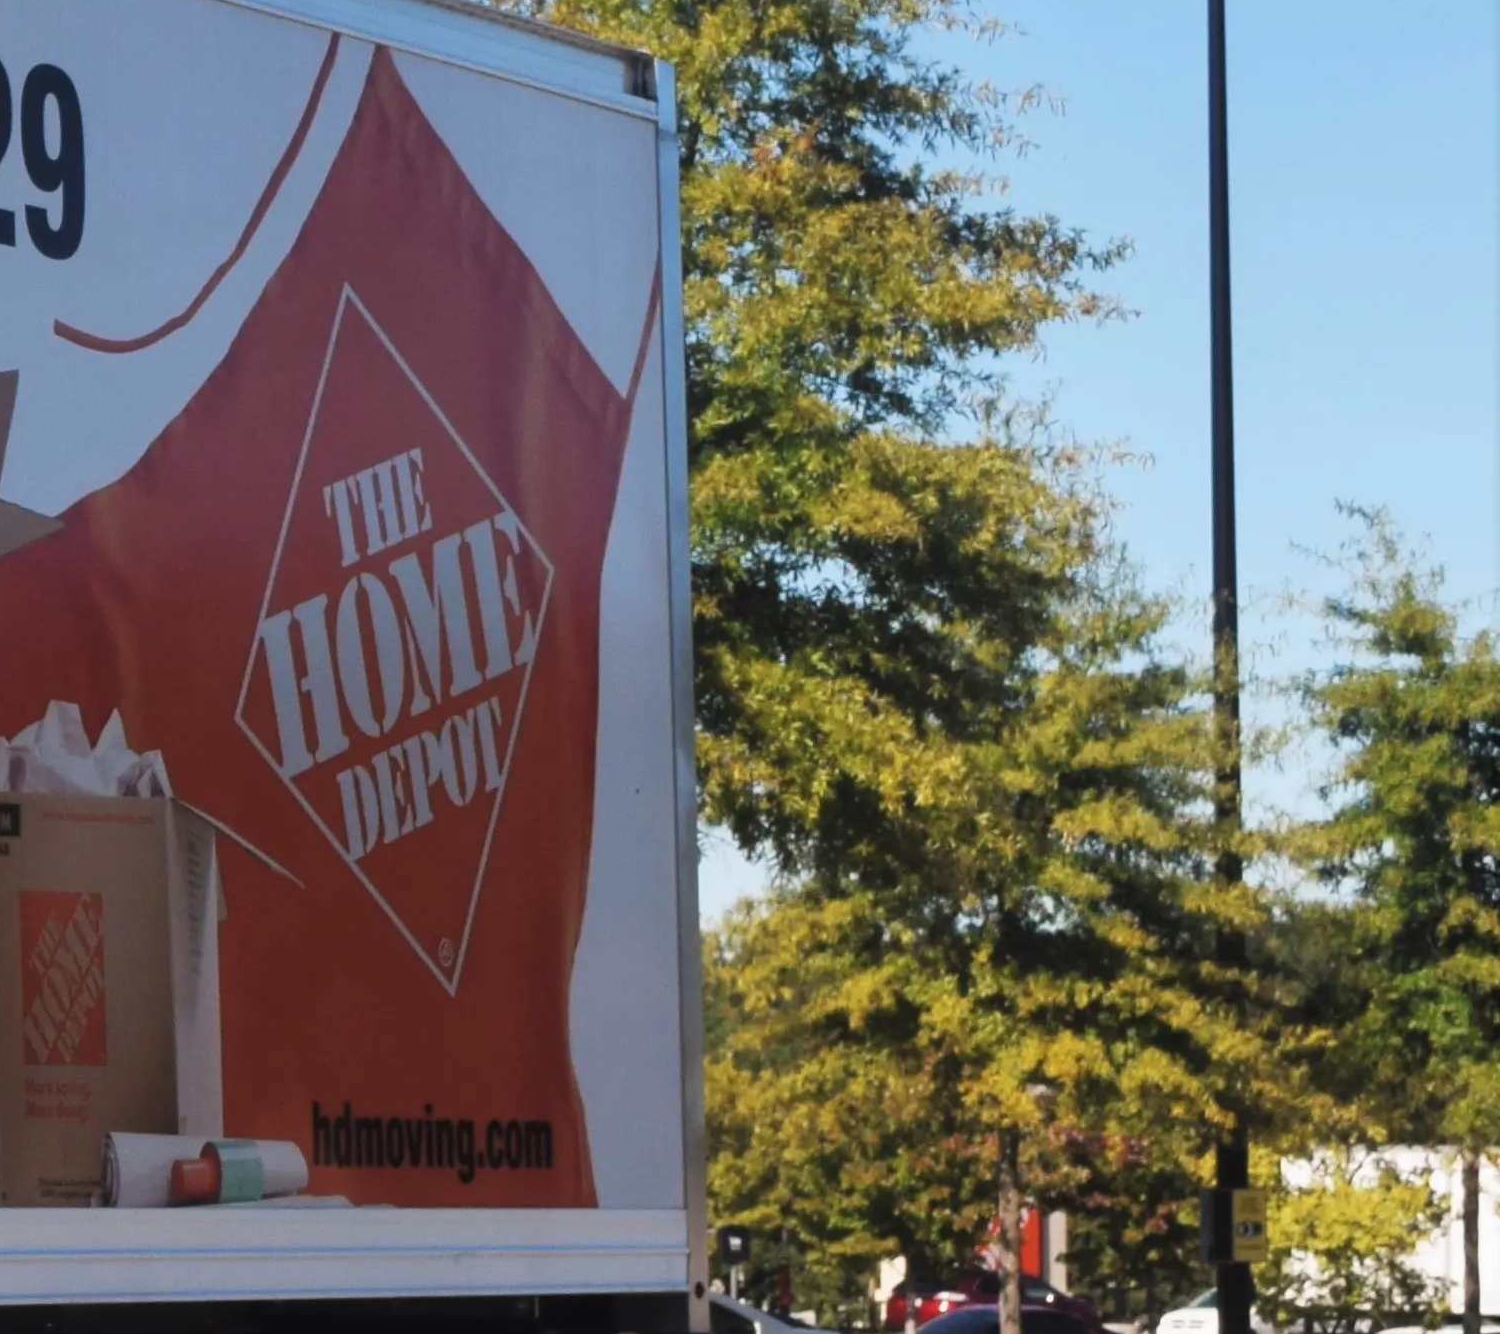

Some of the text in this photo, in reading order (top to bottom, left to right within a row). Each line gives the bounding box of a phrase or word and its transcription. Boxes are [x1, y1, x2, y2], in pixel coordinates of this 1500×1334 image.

[322, 447, 433, 567] THE
[260, 509, 536, 779] HOME
[336, 696, 503, 864] DEPOT
[23, 889, 103, 1064] HOME
[27, 910, 63, 975] THE
[57, 958, 104, 1065] DEPOT
[311, 1099, 553, 1184] hdmoving.com
